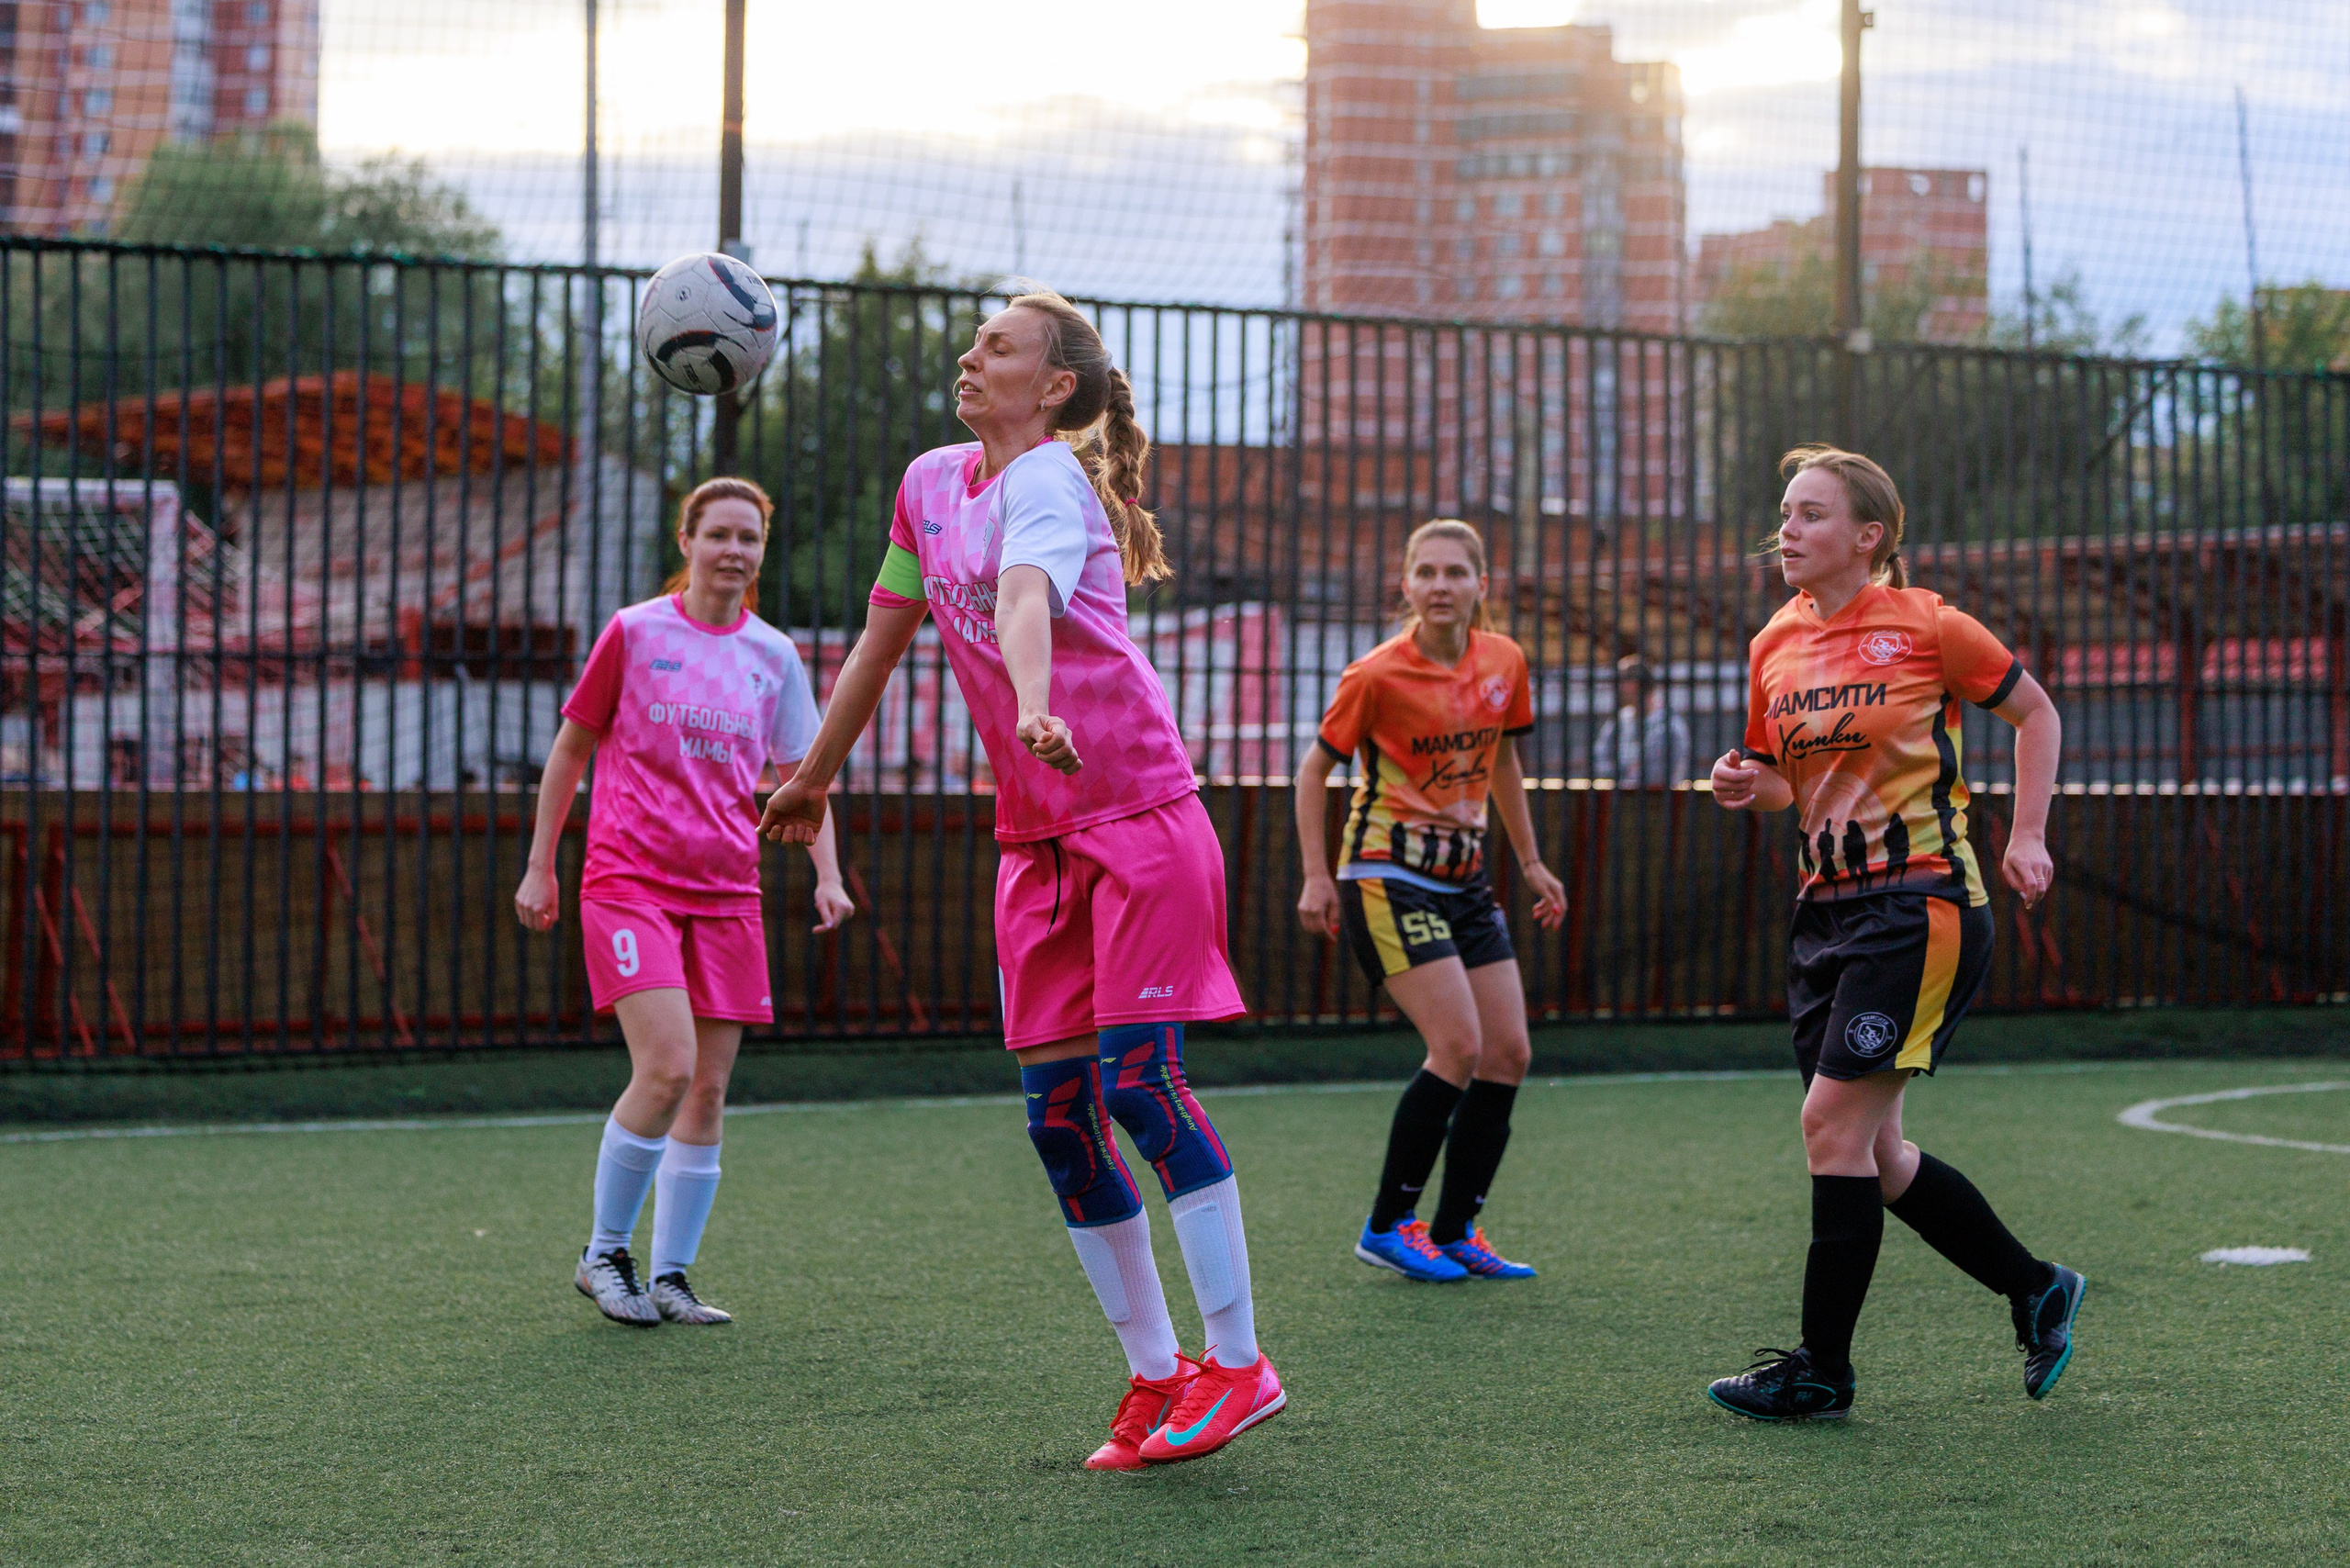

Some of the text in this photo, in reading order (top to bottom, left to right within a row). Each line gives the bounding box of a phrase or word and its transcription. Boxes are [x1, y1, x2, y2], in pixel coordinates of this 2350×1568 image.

[679, 735, 735, 765] МАМЫ
[1402, 910, 1451, 946] 55
[612, 928, 640, 977] 9
